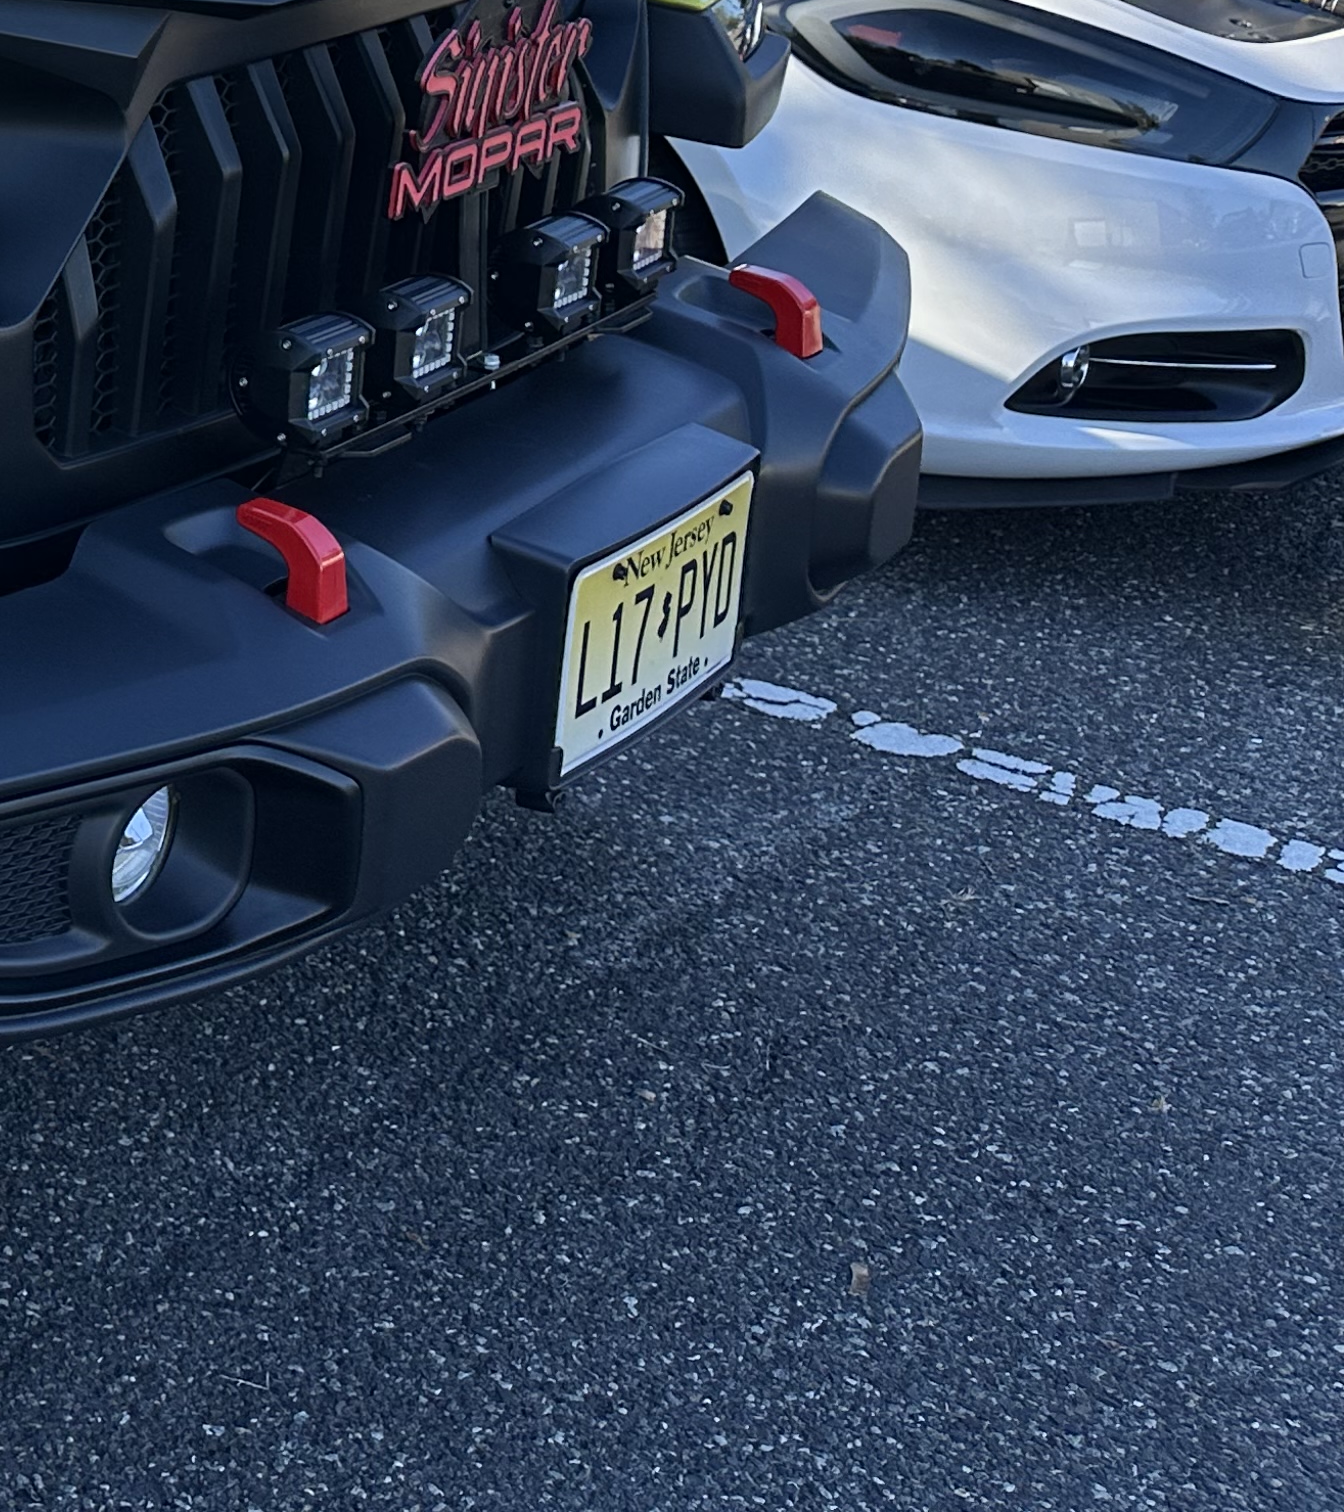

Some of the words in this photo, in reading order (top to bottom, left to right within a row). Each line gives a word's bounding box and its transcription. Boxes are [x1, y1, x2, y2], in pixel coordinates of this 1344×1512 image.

[388, 100, 583, 220] MOPAR
[623, 546, 666, 588] New
[665, 515, 715, 570] Jersey
[574, 583, 656, 720] L17
[672, 531, 737, 659] PYD
[609, 684, 662, 731] Garden
[666, 655, 701, 695] State
